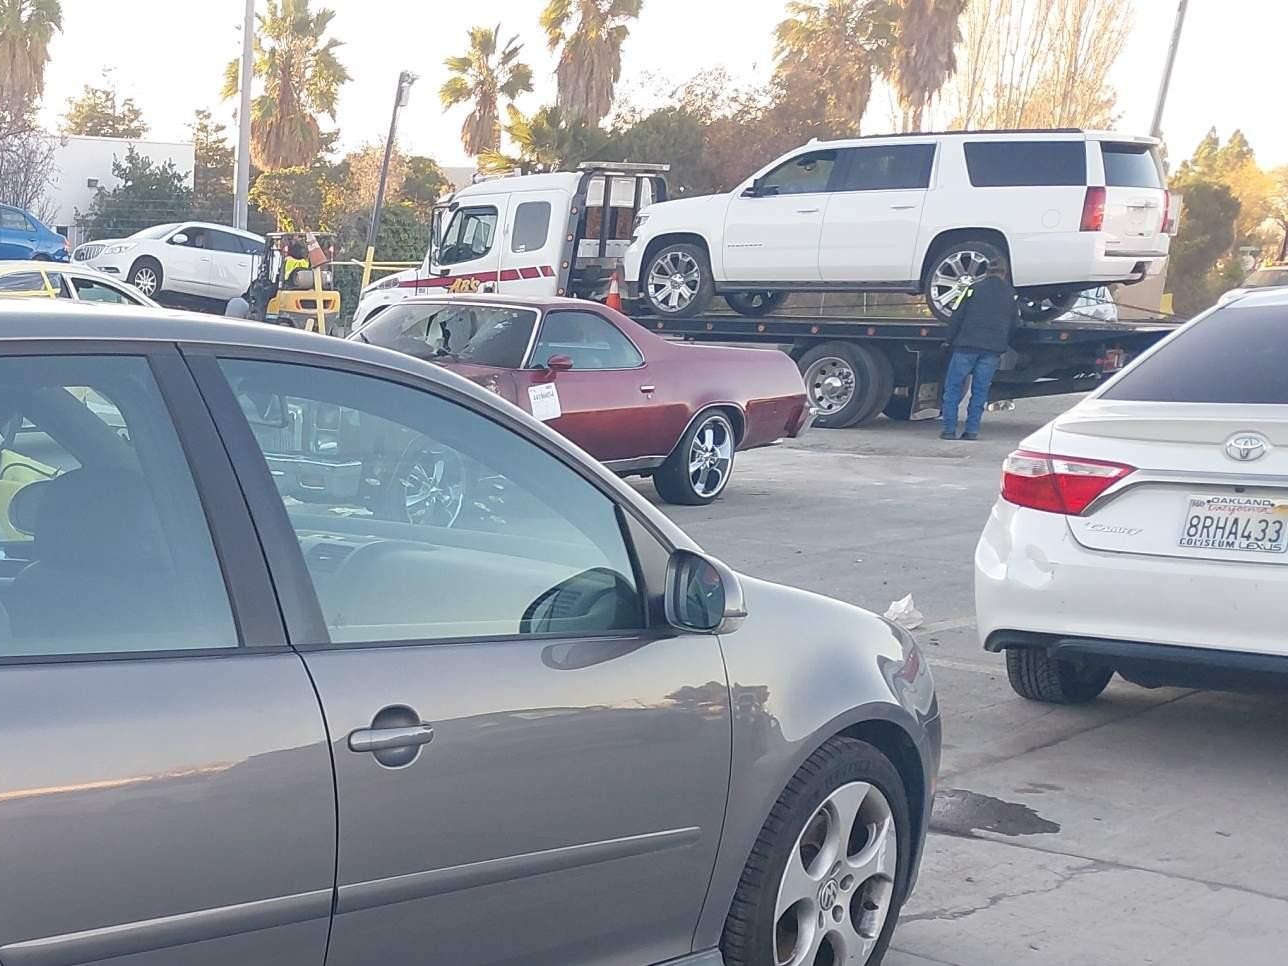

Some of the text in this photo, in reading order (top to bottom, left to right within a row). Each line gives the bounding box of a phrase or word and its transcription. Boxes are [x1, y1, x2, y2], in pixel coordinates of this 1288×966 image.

[1211, 497, 1272, 506] OAKLAND
[1187, 515, 1283, 543] 8RHA433
[1239, 541, 1282, 552] LEXUS
